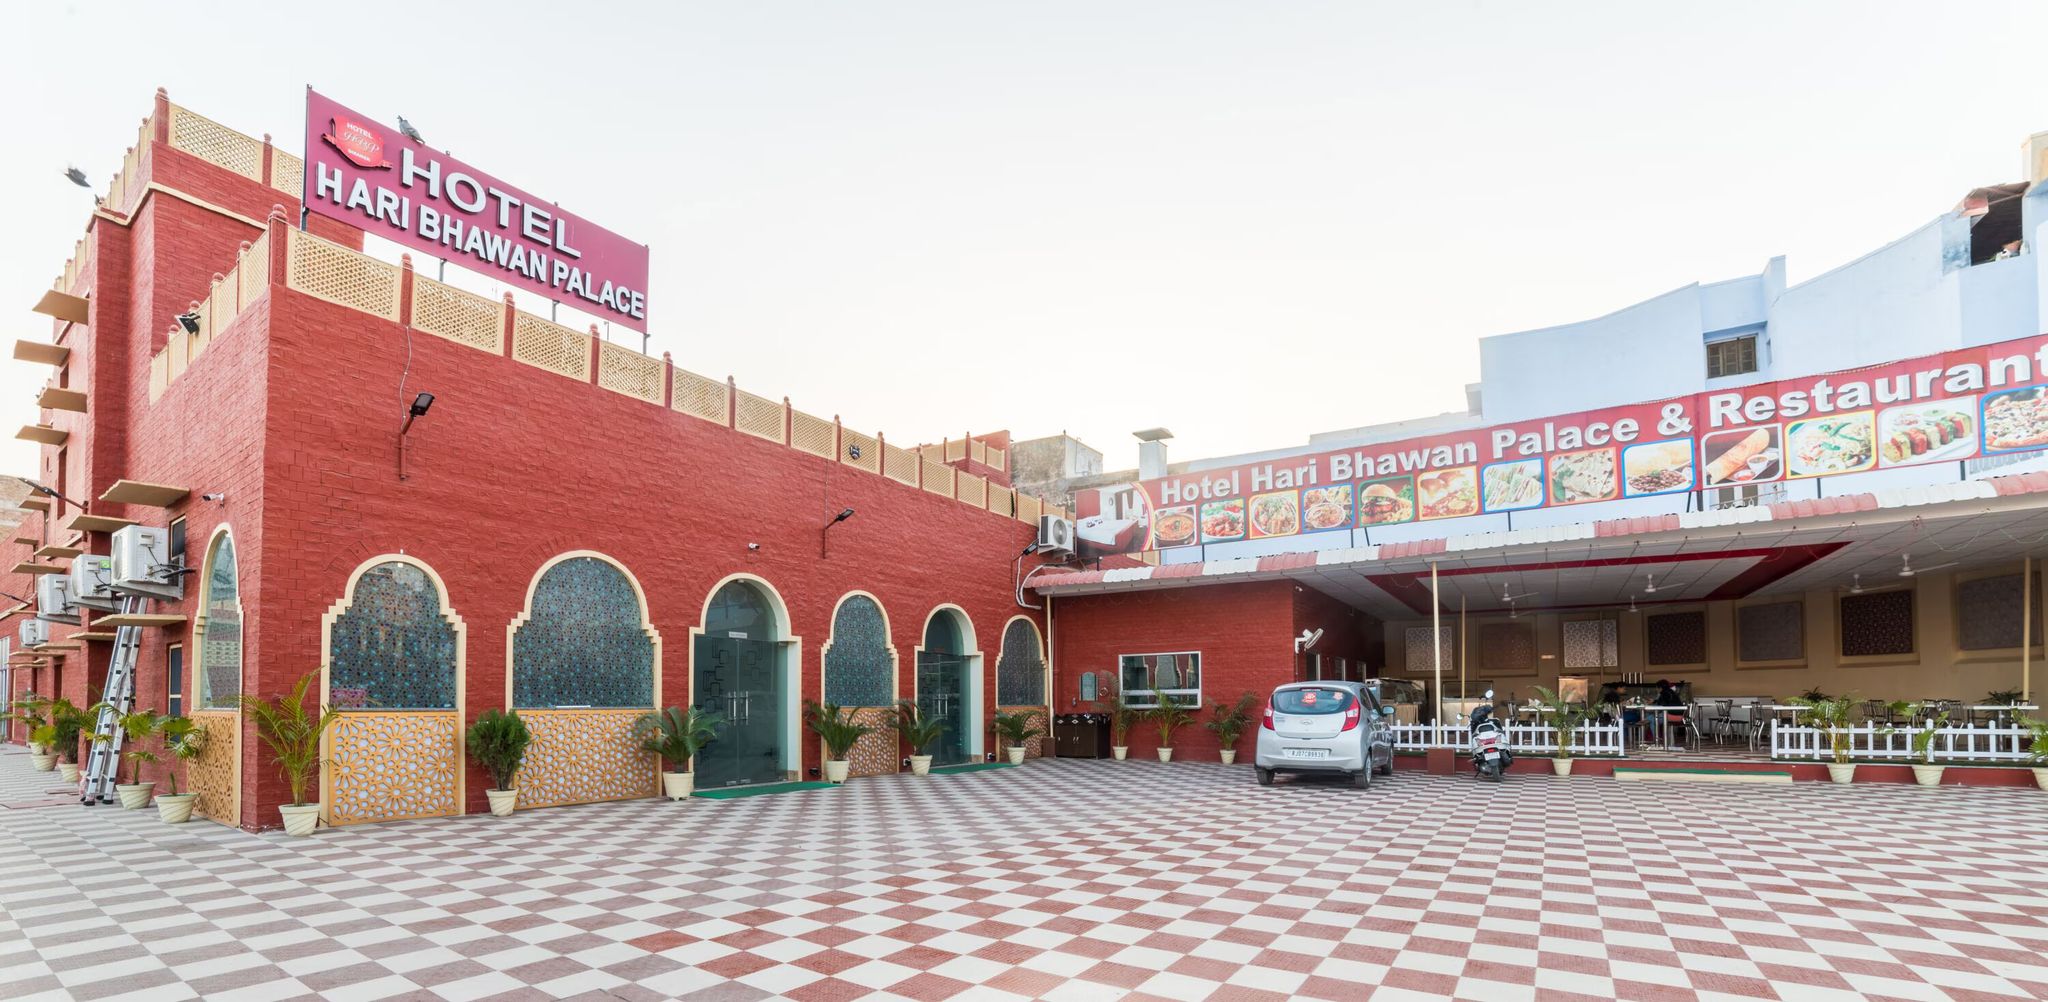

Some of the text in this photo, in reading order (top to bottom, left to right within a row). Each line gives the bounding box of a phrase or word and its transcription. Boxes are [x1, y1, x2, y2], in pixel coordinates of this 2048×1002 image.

[346, 122, 373, 139] HOTEL
[316, 161, 645, 320] HARI BHAWAN PALACE
[401, 147, 581, 259] HOTEL
[1160, 343, 2048, 505] Hotel Hari Bhawan Palace & Restaurant
